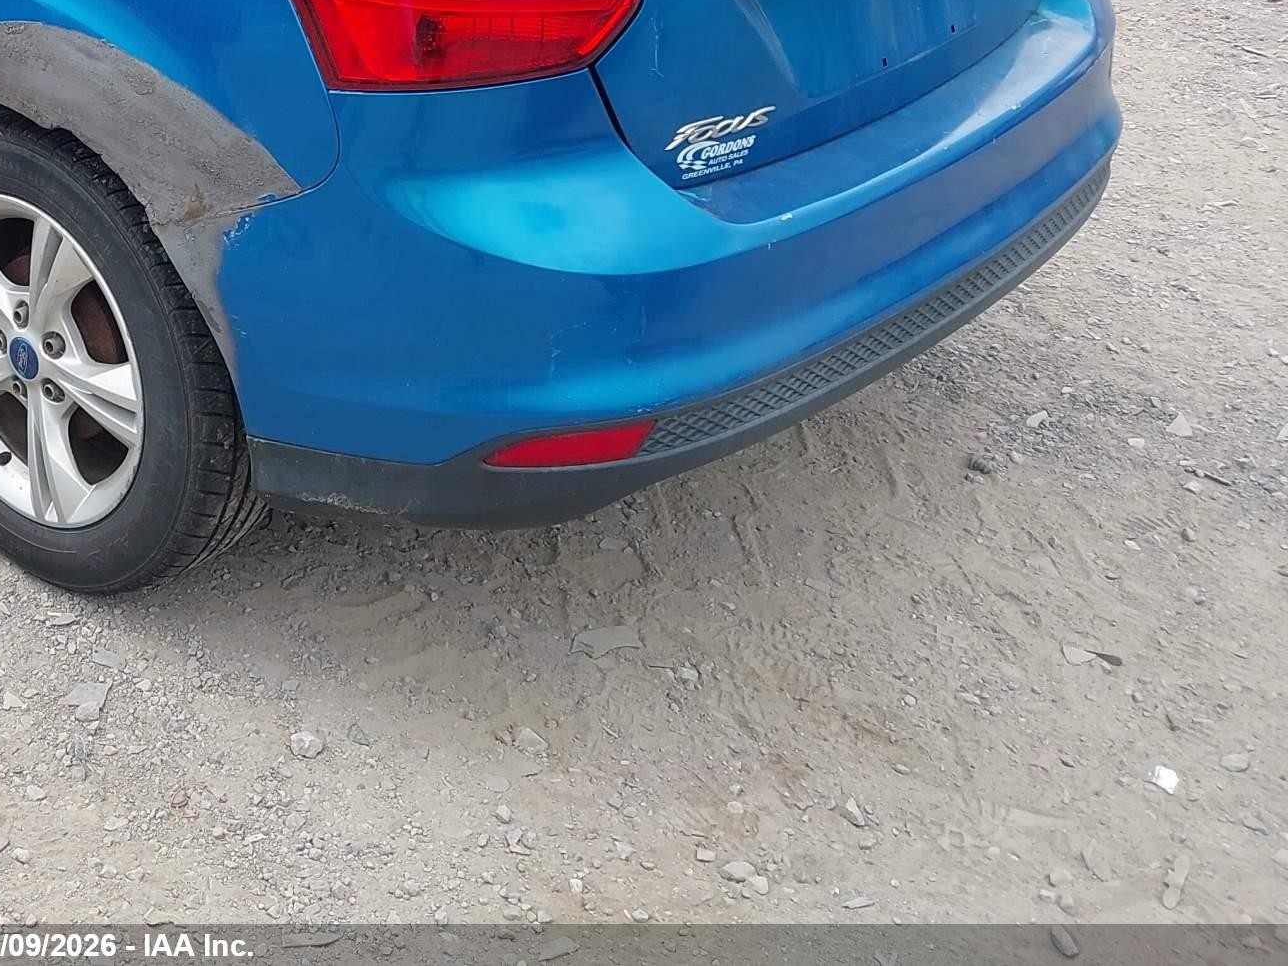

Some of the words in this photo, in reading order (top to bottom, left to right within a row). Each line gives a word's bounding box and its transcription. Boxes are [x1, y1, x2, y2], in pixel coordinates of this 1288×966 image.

[664, 105, 776, 151] Focus
[708, 155, 728, 166] AUTO
[727, 149, 750, 160] SALES
